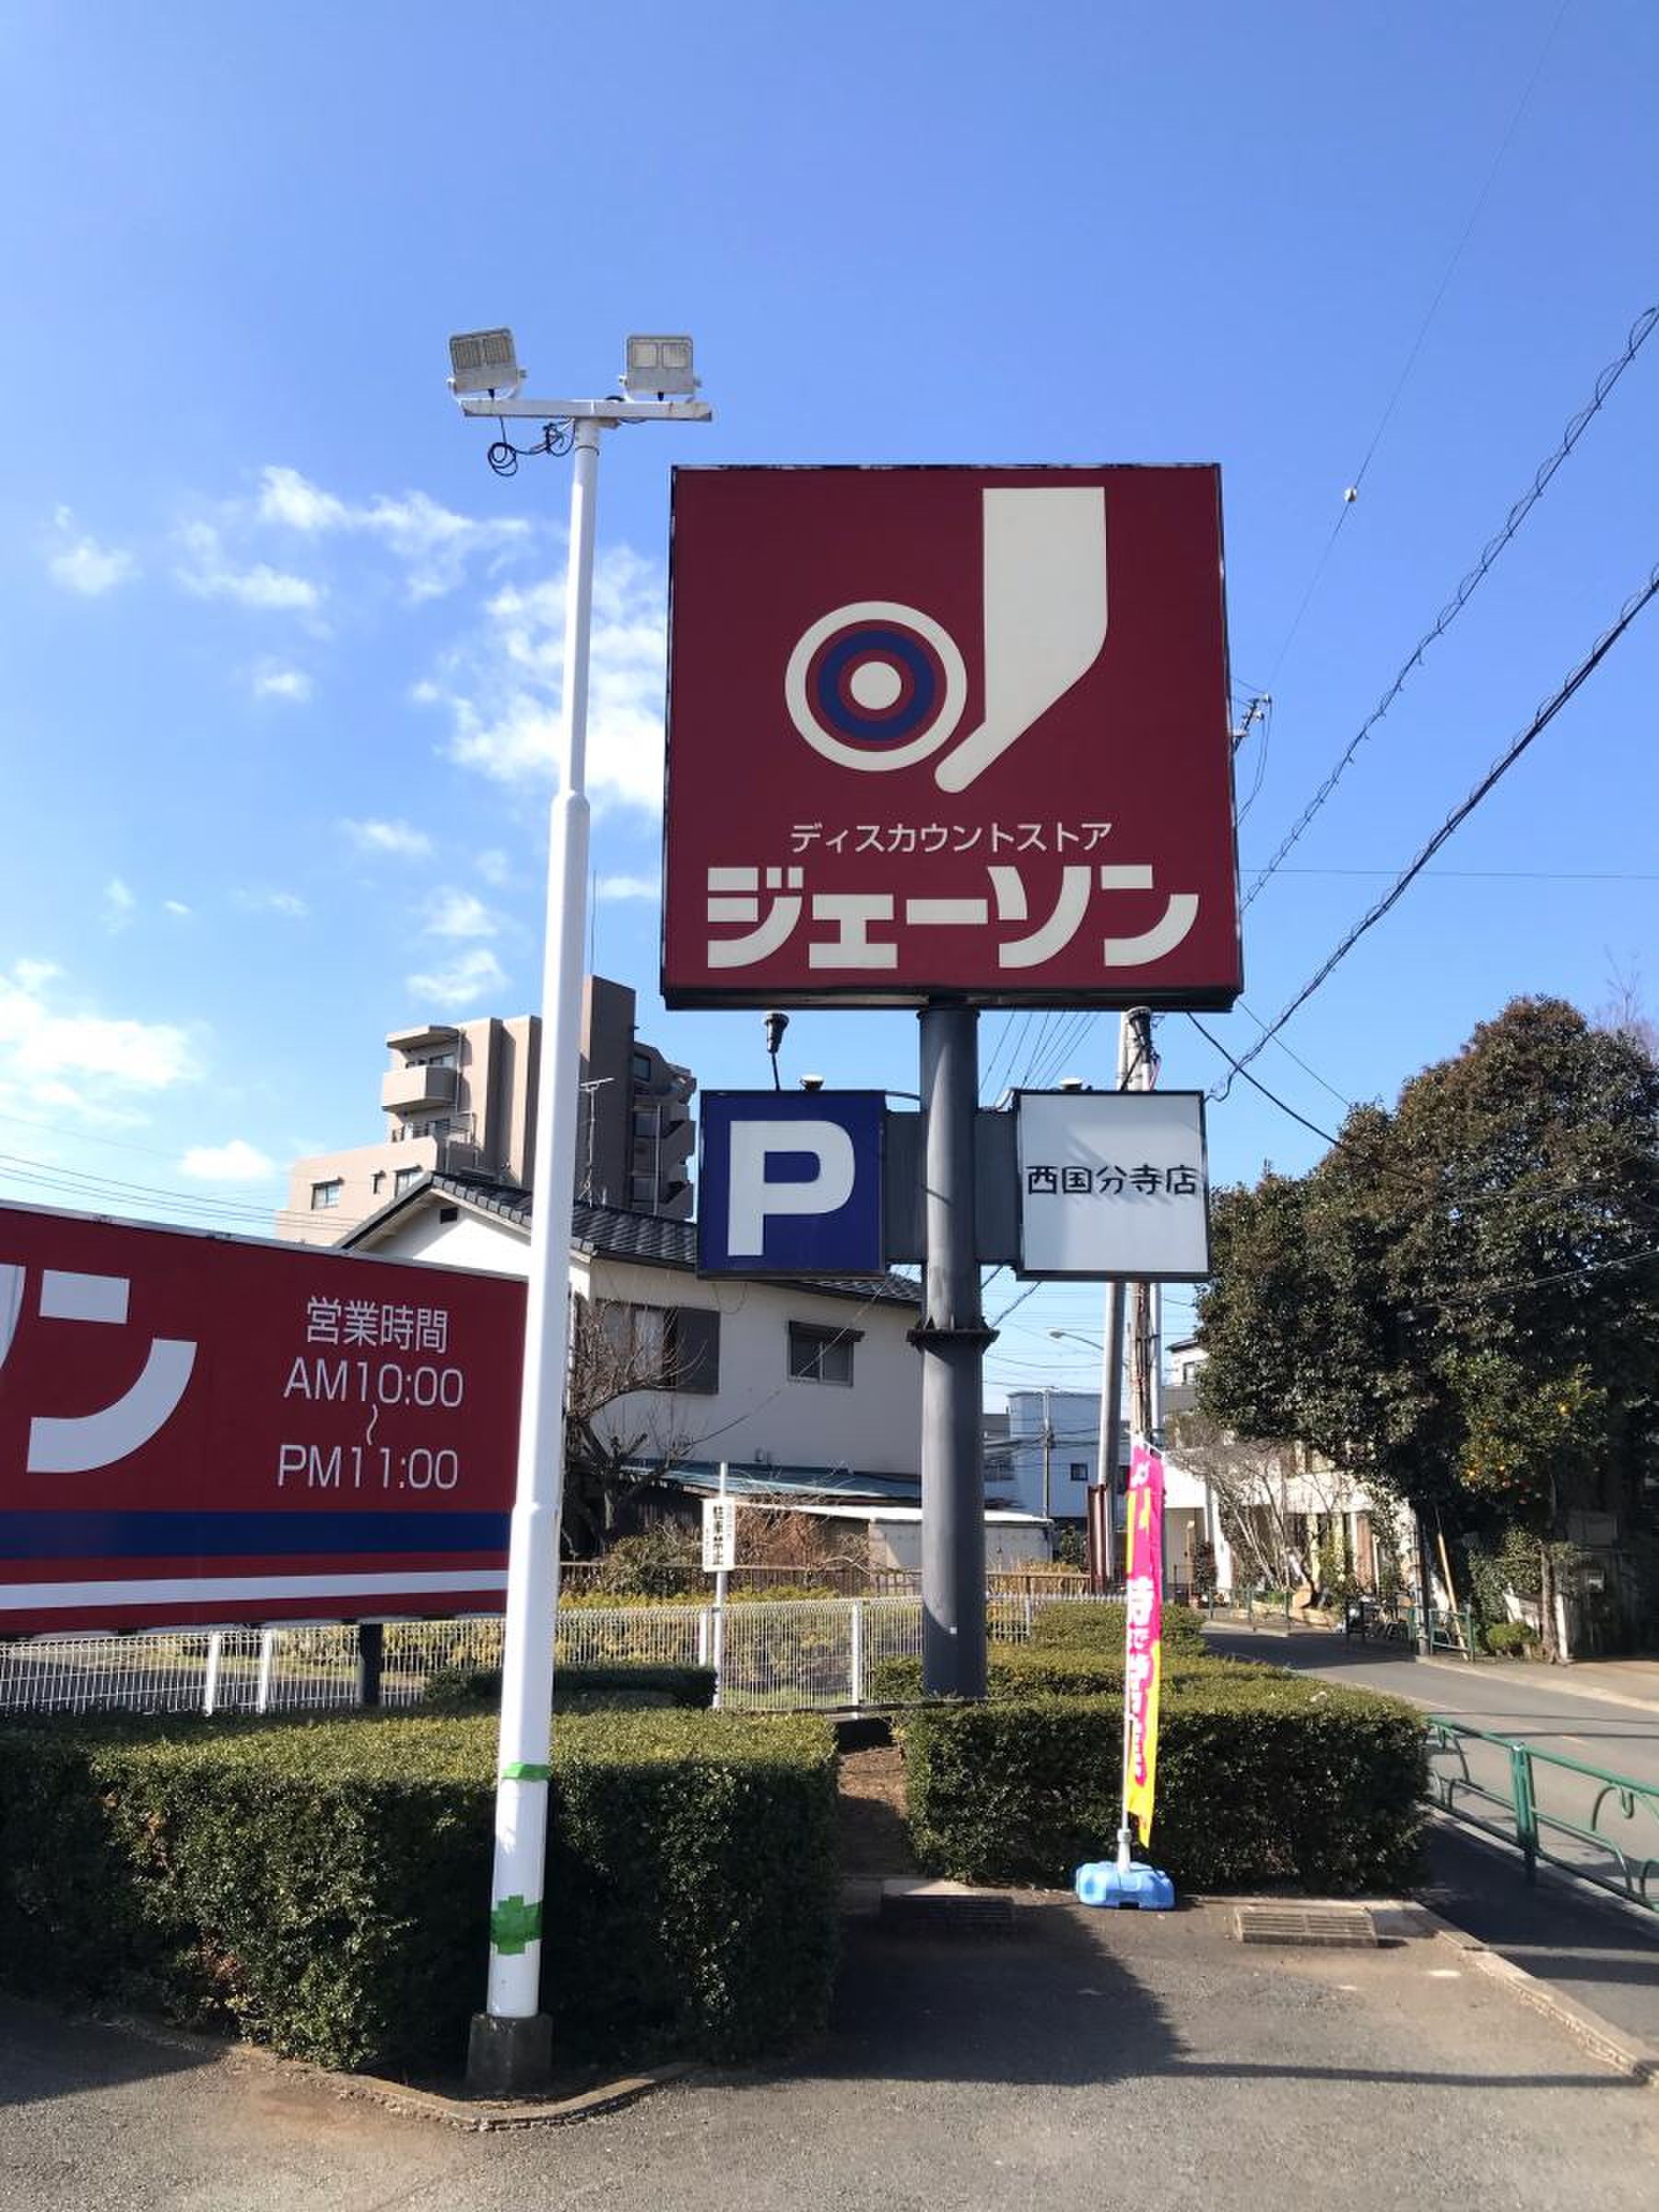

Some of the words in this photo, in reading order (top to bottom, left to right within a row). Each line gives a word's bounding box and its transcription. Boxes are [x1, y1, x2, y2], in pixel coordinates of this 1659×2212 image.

[790, 821, 1112, 853] ディスカウントストア
[707, 865, 1199, 970] ジェーソン
[727, 1120, 855, 1256] P
[1026, 1164, 1197, 1195] 西国分寺店
[306, 1295, 449, 1355] 営業時間
[0, 1264, 197, 1474] ン
[283, 1357, 464, 1408] AM10:00
[277, 1444, 459, 1490] PM11:00
